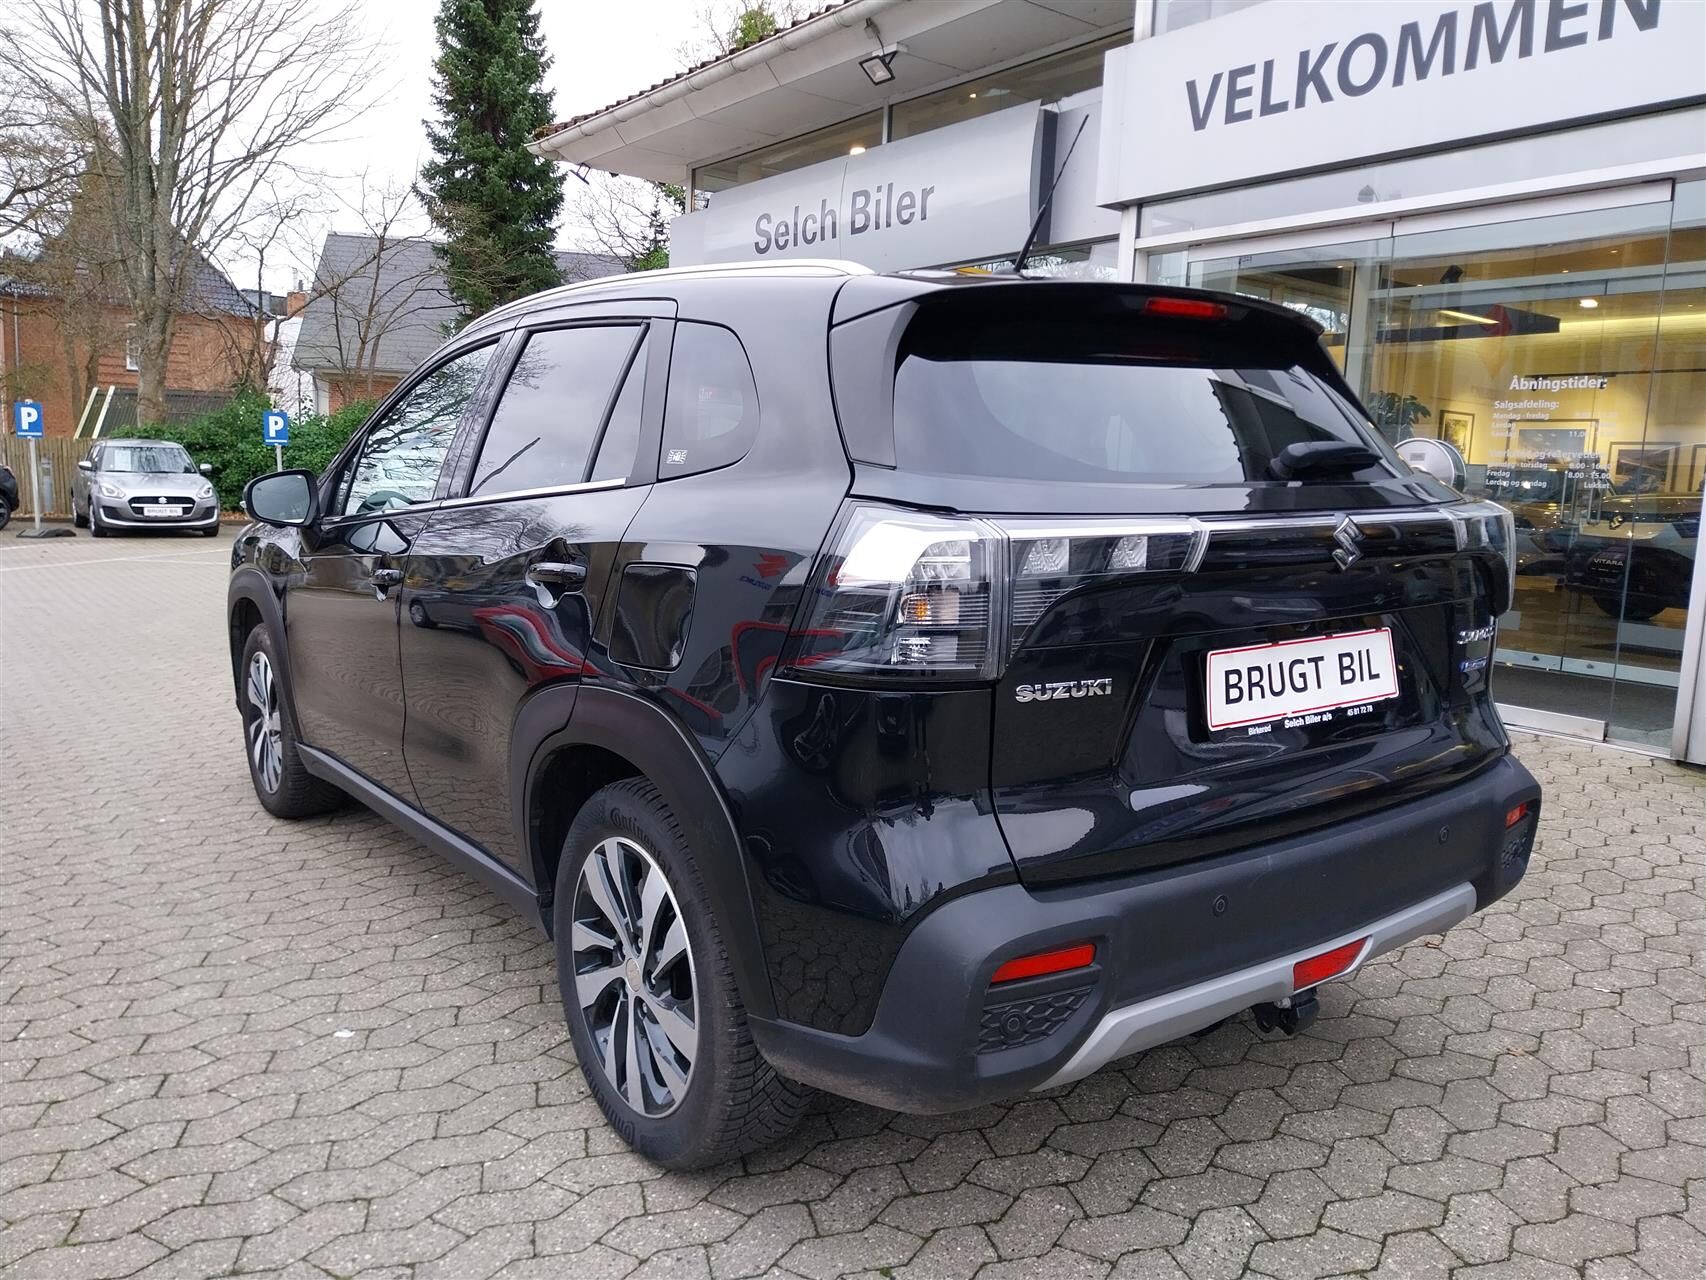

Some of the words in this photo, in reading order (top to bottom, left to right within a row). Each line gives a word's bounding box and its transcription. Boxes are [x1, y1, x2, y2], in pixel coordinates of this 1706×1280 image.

[754, 198, 838, 255] Selch
[850, 182, 935, 236] Biler
[1510, 375, 1607, 391] Åbningstider:
[1494, 399, 1560, 411] Salgsafdeling:
[20, 406, 38, 430] P
[268, 415, 284, 438] P
[1486, 470, 1510, 478] Fredag
[1567, 471, 1584, 479] 8.00
[1589, 471, 1612, 480] 15.00
[1510, 481, 1521, 489] og
[1521, 480, 1547, 488] sndag
[1593, 558, 1623, 566] VITARA
[1224, 655, 1325, 705] BRUGT
[1337, 647, 1381, 686] BIL
[1015, 678, 1113, 703] SUZUKI
[1284, 715, 1305, 729] Selch
[1305, 713, 1322, 726] Biler
[1321, 711, 1333, 723] a/s
